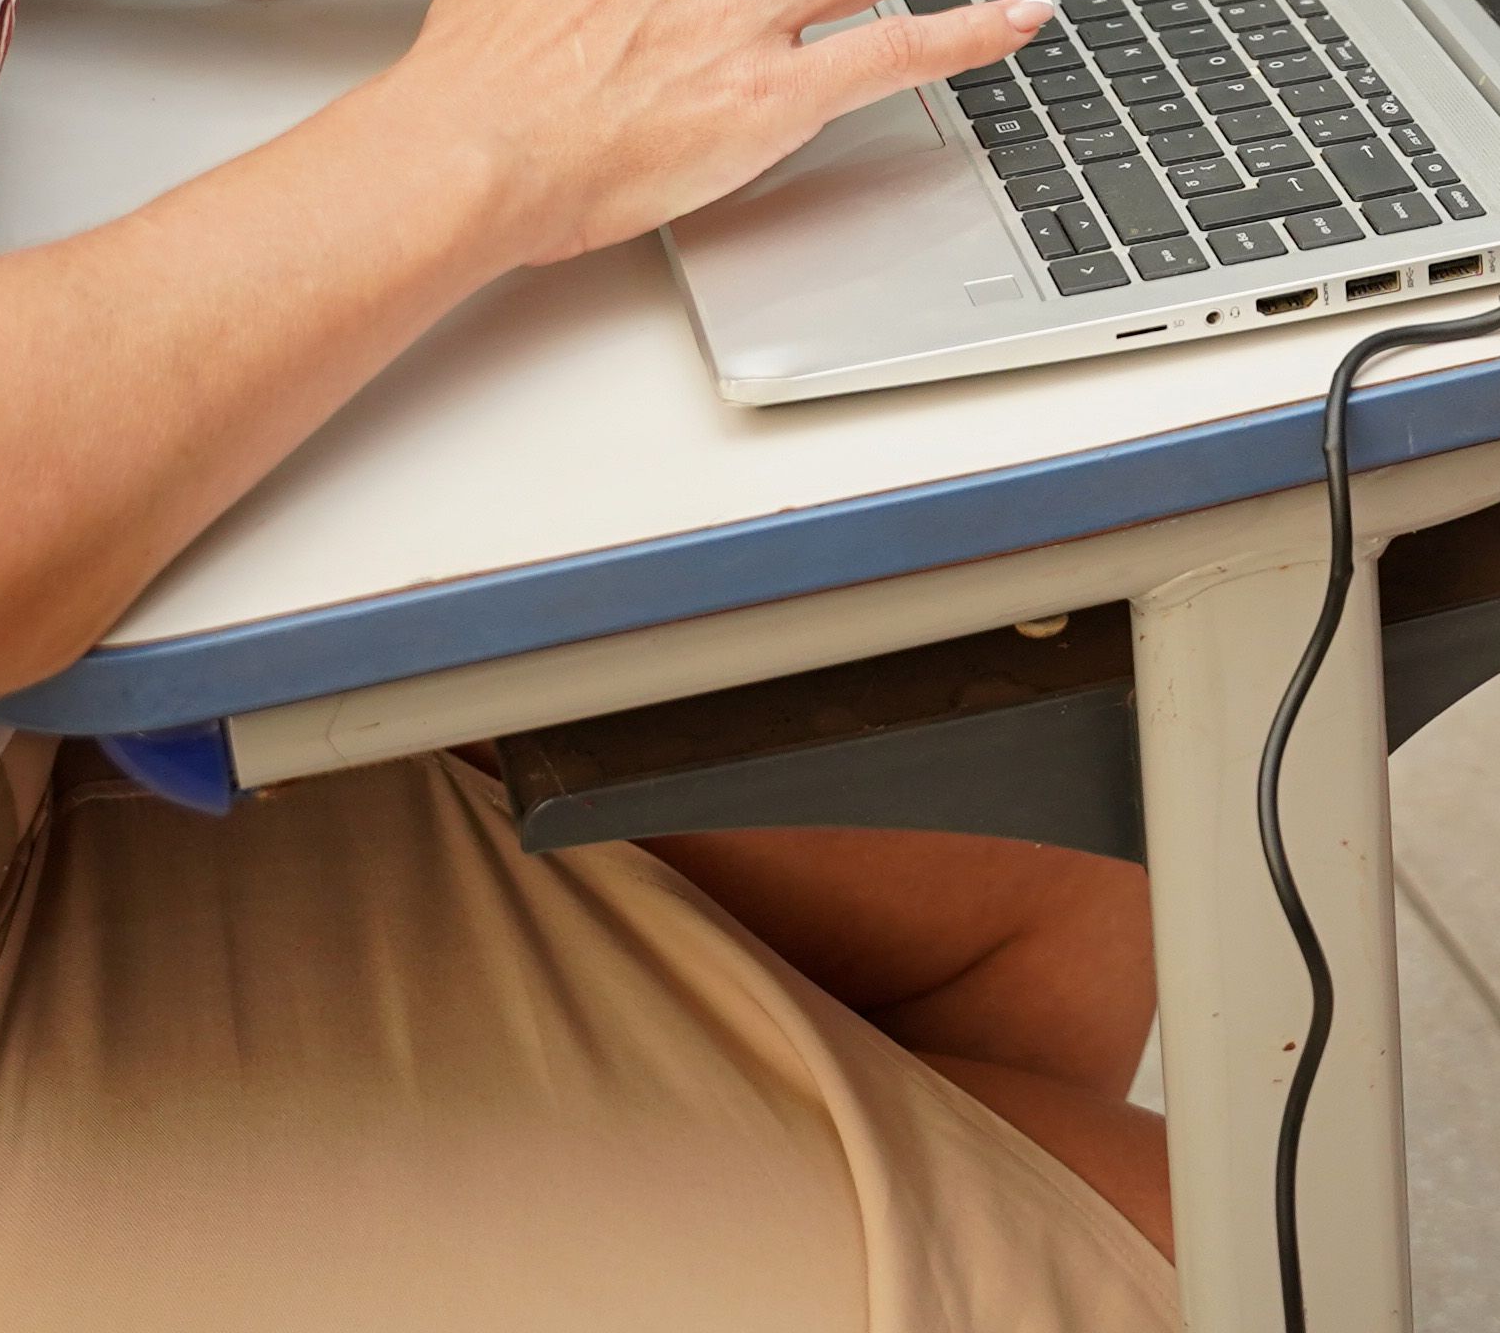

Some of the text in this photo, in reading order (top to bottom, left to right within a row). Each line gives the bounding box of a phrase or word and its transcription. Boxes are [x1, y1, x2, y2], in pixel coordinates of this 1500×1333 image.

[1171, 2, 1189, 12] U
[1229, 7, 1246, 15] 8
[1106, 21, 1123, 30] J
[1249, 34, 1265, 42] 9
[1044, 46, 1063, 56] M
[1123, 47, 1142, 57] K
[1208, 56, 1227, 66] O
[1141, 75, 1158, 84] L
[1227, 83, 1245, 92] P
